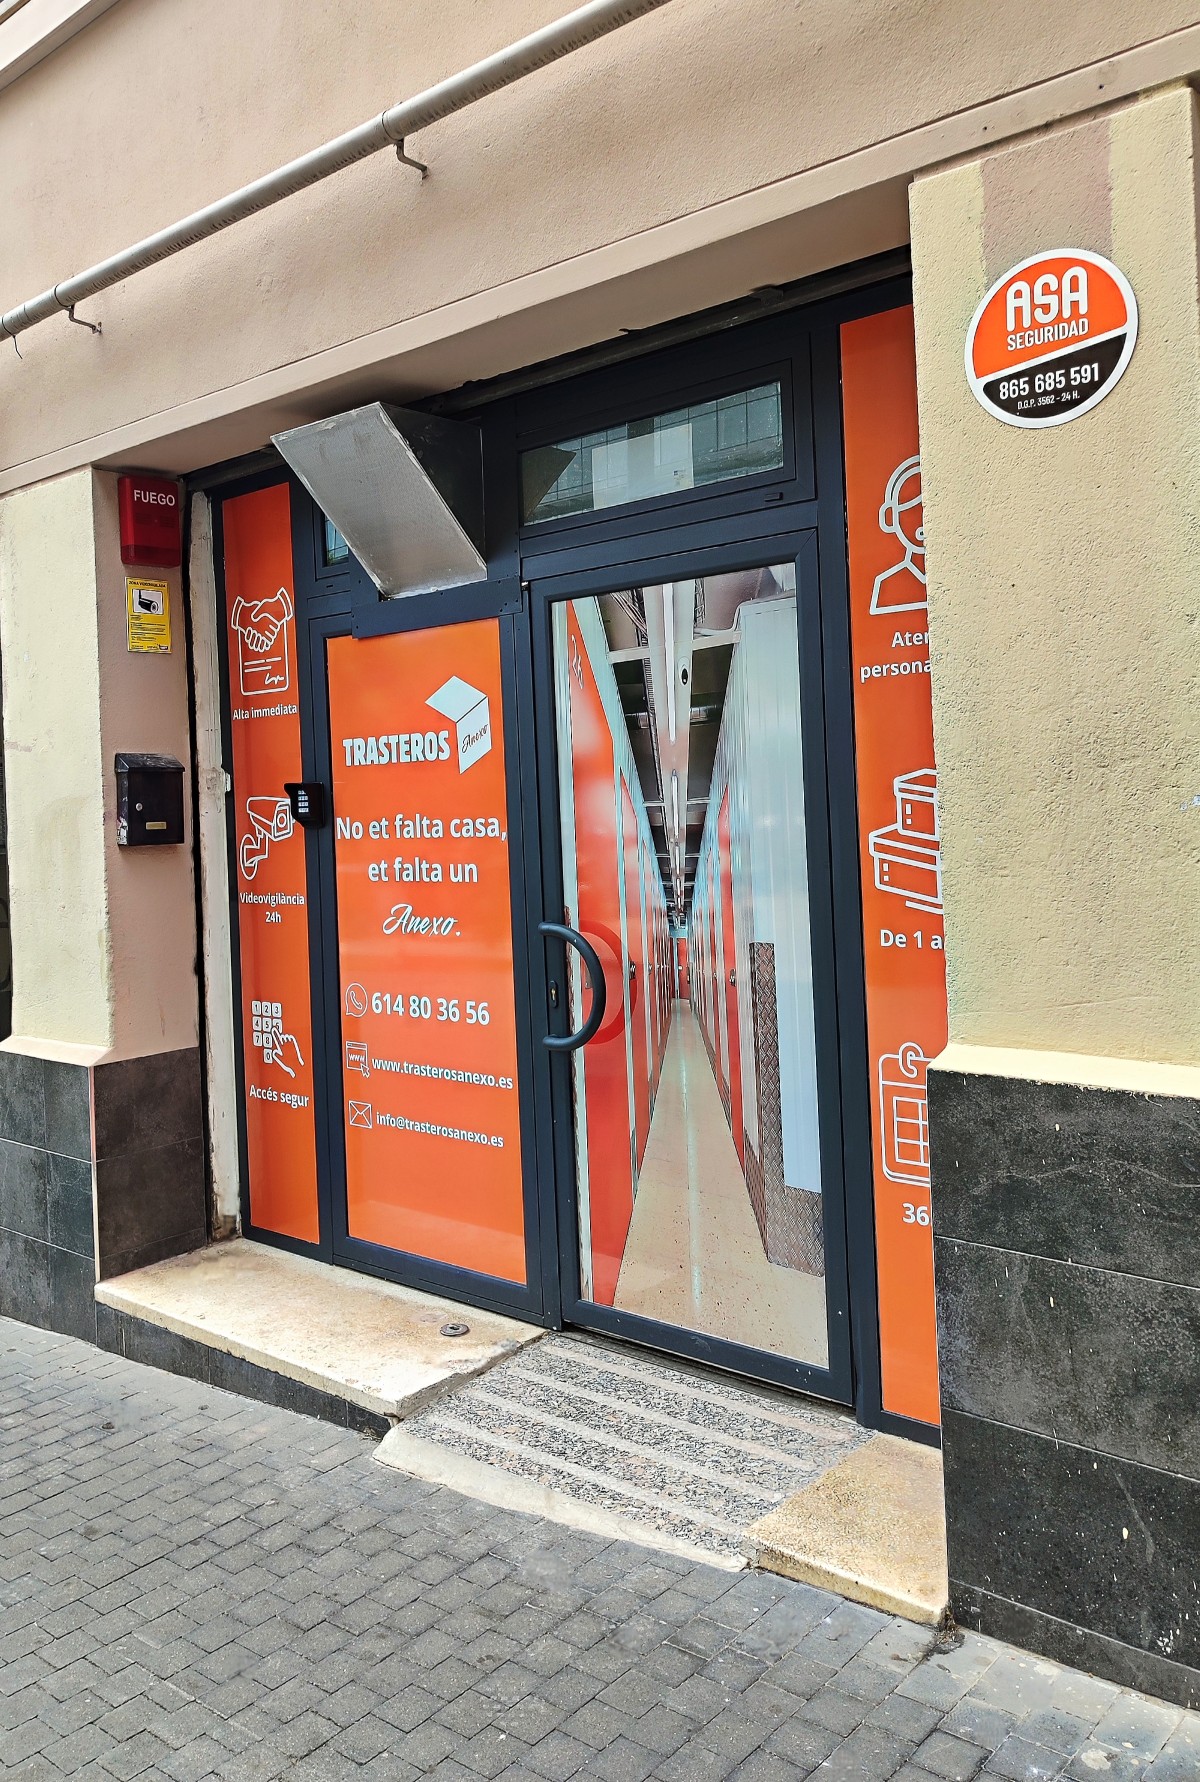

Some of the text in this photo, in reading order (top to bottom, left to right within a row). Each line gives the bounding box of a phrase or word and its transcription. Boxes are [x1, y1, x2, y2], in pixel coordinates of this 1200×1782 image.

[1006, 266, 1088, 332] ASA
[1007, 318, 1088, 351] SEGURIDAD
[999, 362, 1099, 399] 865 685 591
[1017, 398, 1036, 410] D.G.P.
[1037, 395, 1055, 406] 3562
[1061, 392, 1071, 403] 24
[1072, 390, 1080, 400] H.
[133, 490, 176, 506] FUEGO
[232, 703, 298, 721] Alta immediata
[343, 730, 450, 767] TRASTEROS
[461, 723, 489, 754] Anexo
[336, 813, 508, 842] No et falta casa,
[368, 856, 478, 883] et falta un
[239, 891, 305, 908] Videovigilància
[265, 911, 282, 923] 24h
[382, 903, 461, 937] Anexo.
[880, 929, 943, 950] De 1 a
[371, 992, 490, 1026] 614 80 36 56
[371, 1057, 513, 1090] www.trasterosanexo.es
[249, 1084, 309, 1109] Accés segur
[376, 1111, 504, 1148] info@trasterosanexo.es
[902, 1202, 930, 1227] 36
